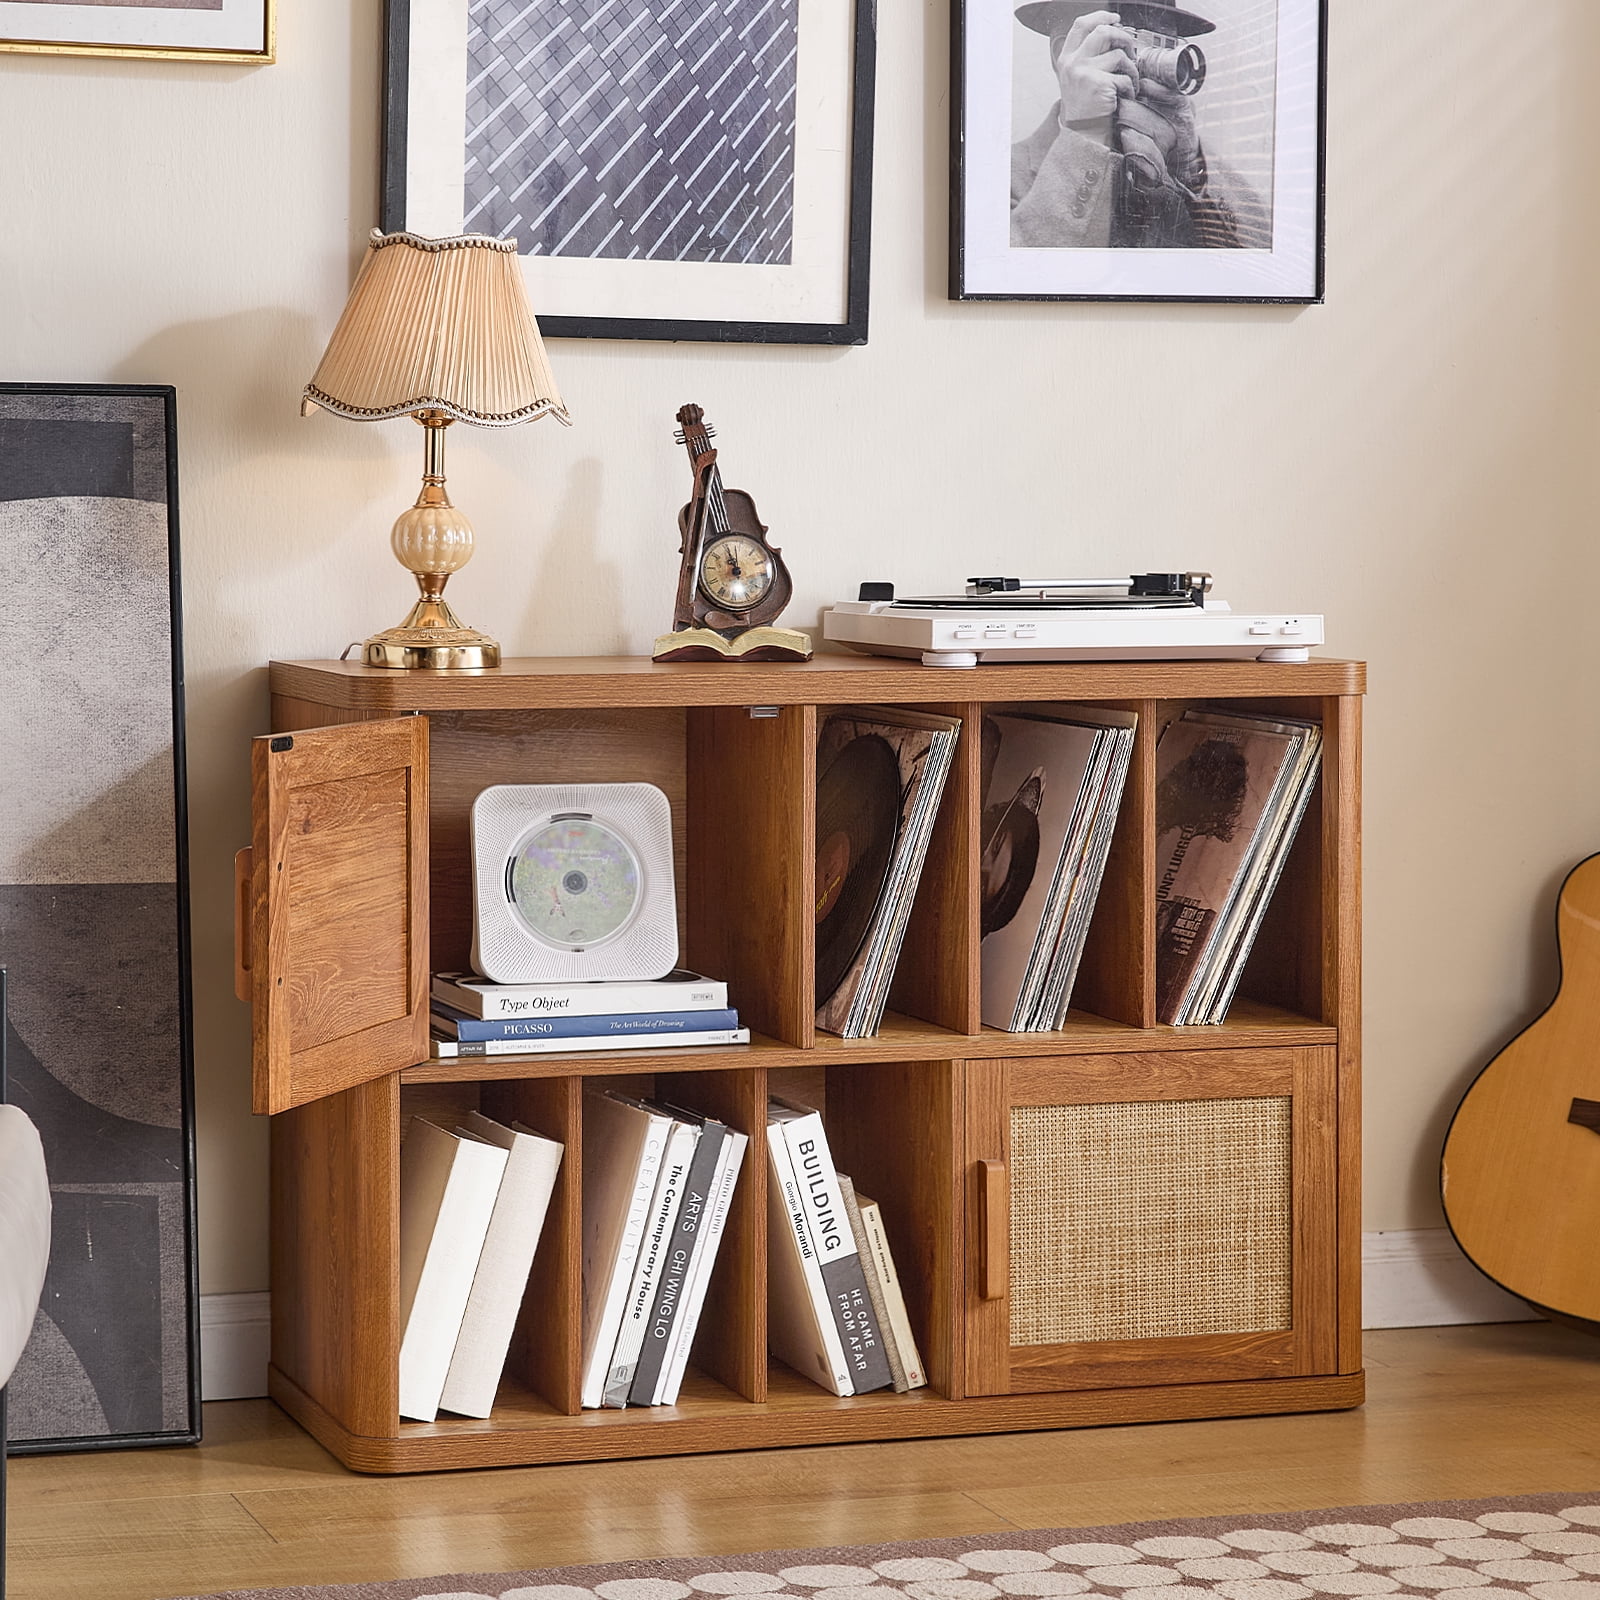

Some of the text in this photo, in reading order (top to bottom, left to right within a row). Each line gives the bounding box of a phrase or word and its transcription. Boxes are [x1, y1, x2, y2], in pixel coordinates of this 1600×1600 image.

[1156, 826, 1195, 900] UNPLUGGED
[500, 996, 570, 1013] Type Object
[503, 1023, 553, 1035] PICASSO
[610, 1021, 621, 1029] The
[632, 1020, 650, 1028] World
[650, 1019, 658, 1028] of
[621, 1139, 659, 1264] CREATIVITY
[682, 1191, 703, 1233] ARTS
[711, 1168, 735, 1234] PHOTO GRAPHY
[785, 1181, 814, 1260] Giorgio Morandi
[798, 1139, 842, 1252] BUILDING
[633, 1165, 683, 1320] The Contemporary House
[654, 1250, 687, 1339] CHI WING LO
[850, 1288, 875, 1348] HE CAME
[837, 1293, 867, 1371] FROM AFAR
